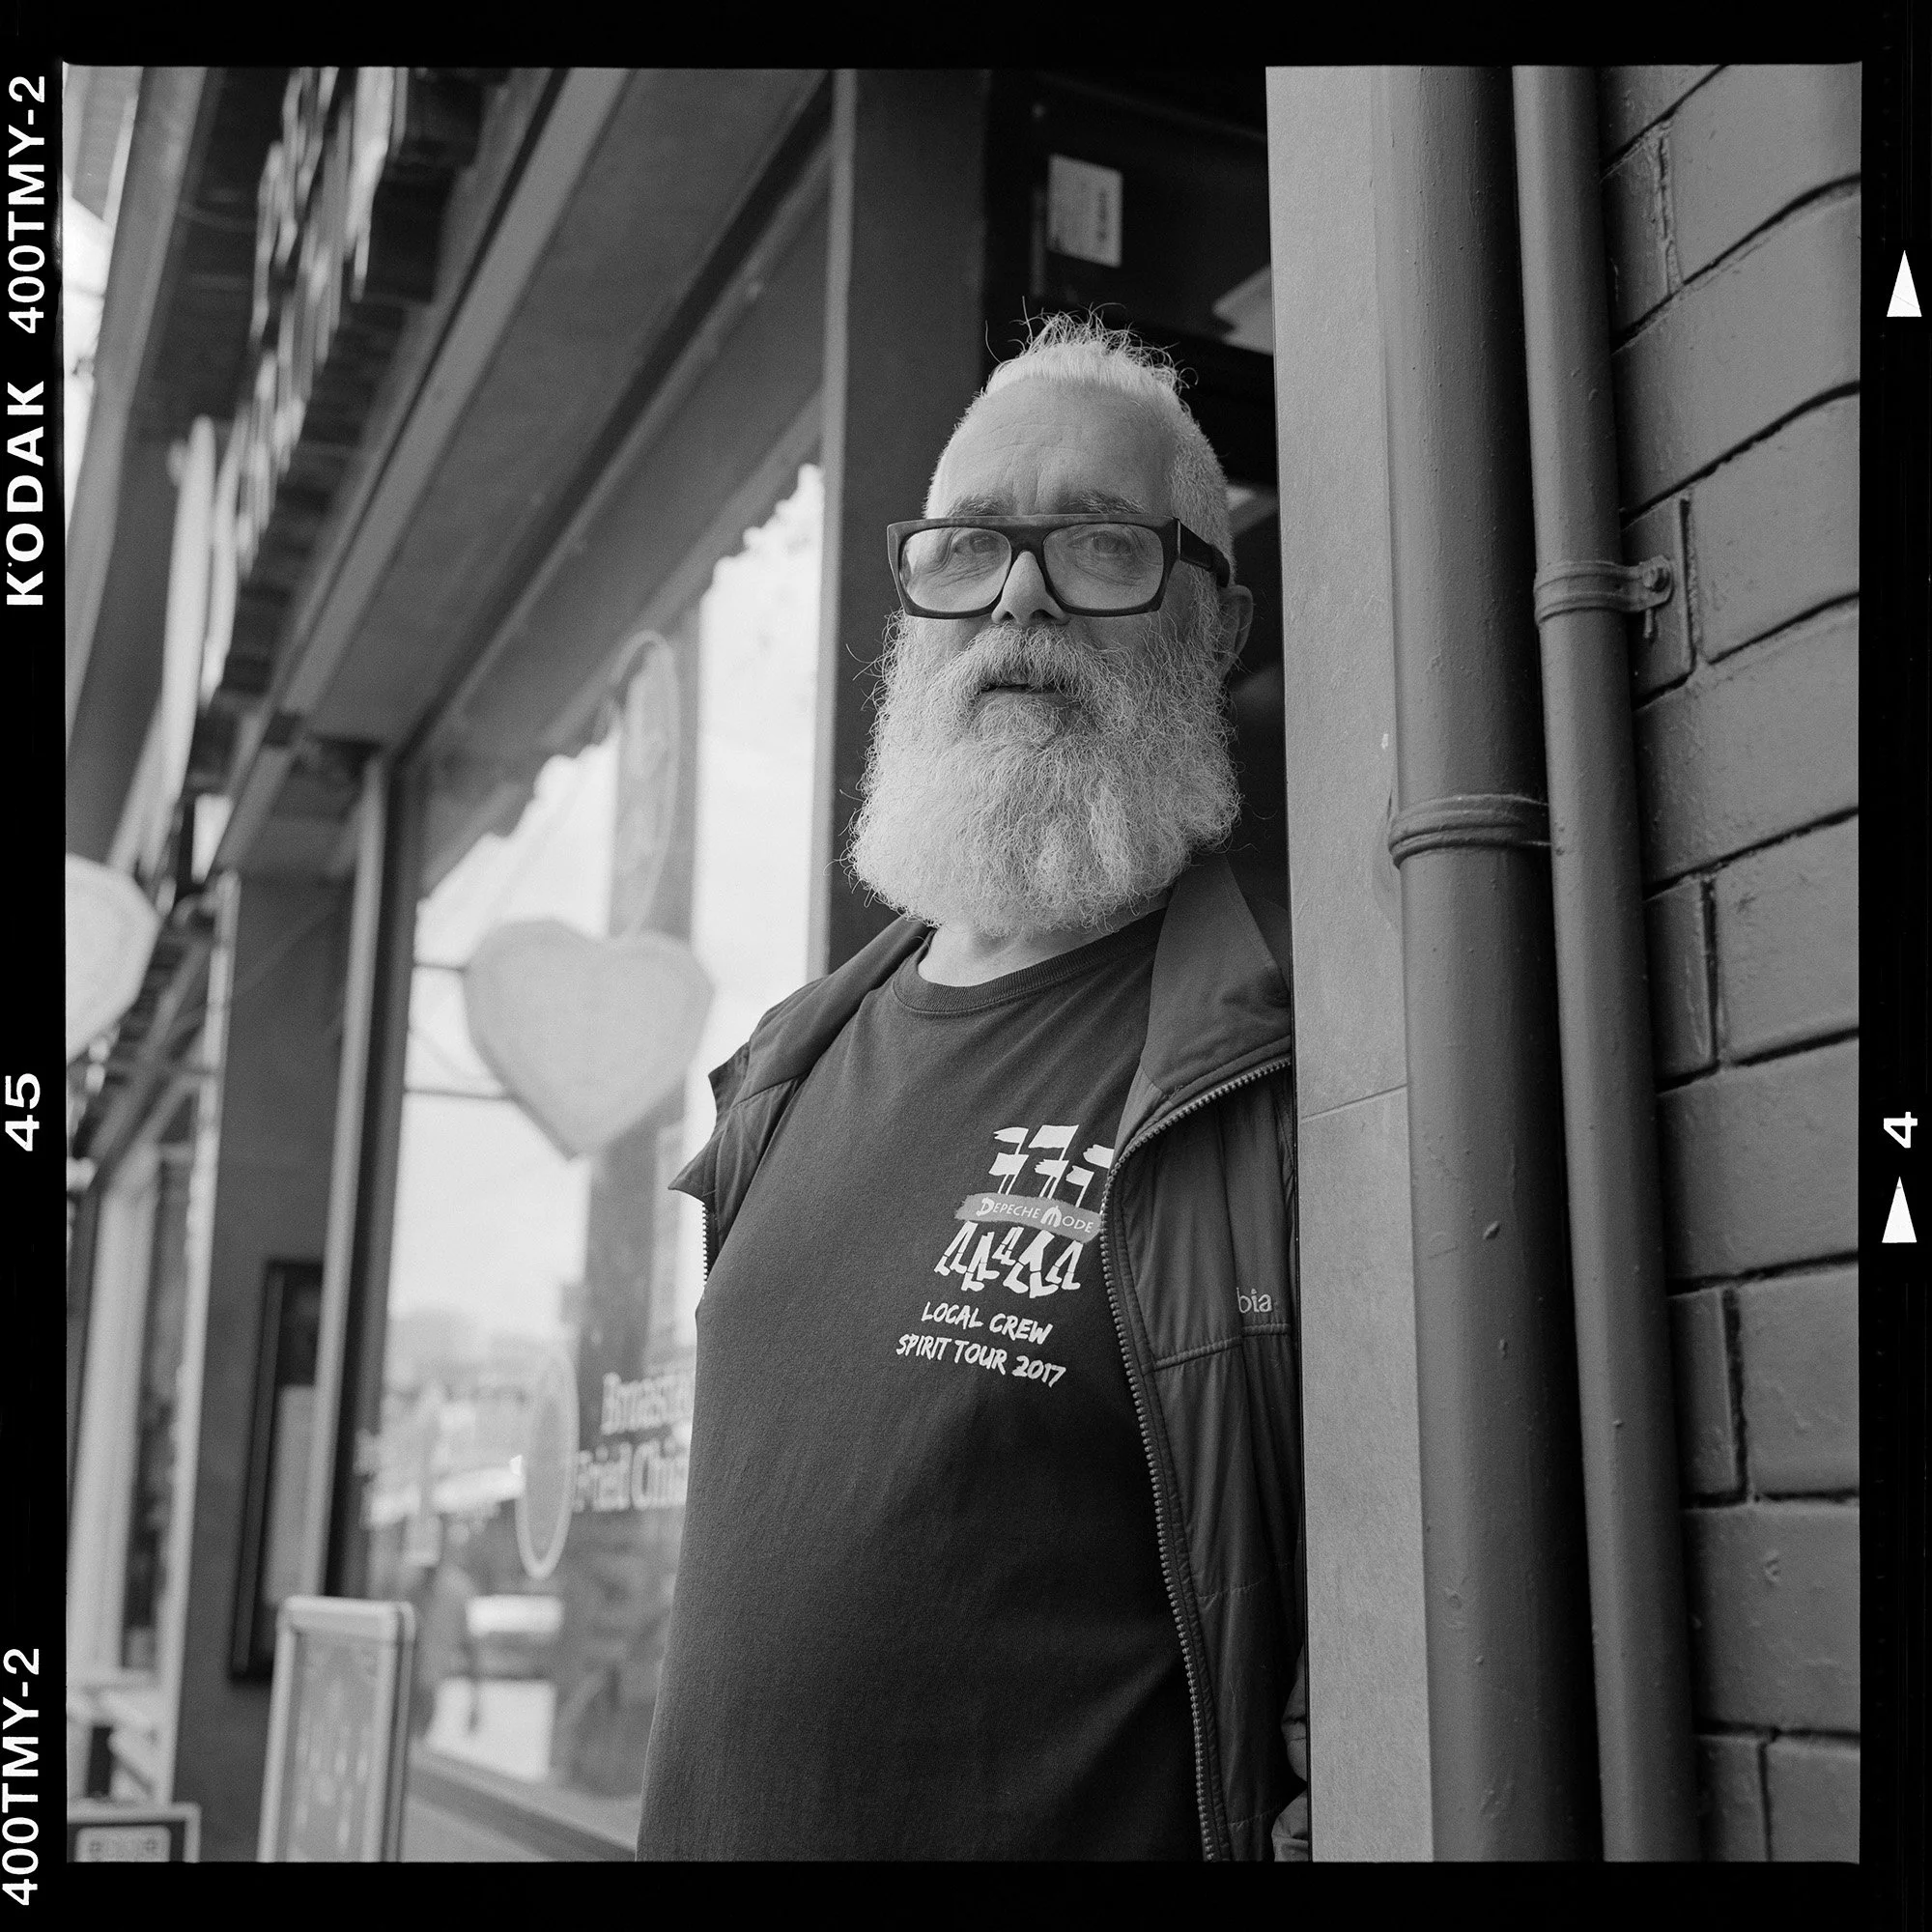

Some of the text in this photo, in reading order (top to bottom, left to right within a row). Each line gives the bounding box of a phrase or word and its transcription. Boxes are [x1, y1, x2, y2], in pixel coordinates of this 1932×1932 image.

[6, 76, 45, 606] KODAK 400TMY-2
[6, 1073, 40, 1151] 45
[1883, 1111, 1918, 1149] 4
[976, 1197, 1094, 1233] DEPECHE MODE
[921, 1301, 1053, 1345] LOCAL CREW
[1236, 1287, 1272, 1313] bia
[895, 1333, 1066, 1387] SPIRIT TOUR 2017
[2, 1649, 39, 1906] 400TMY-2
